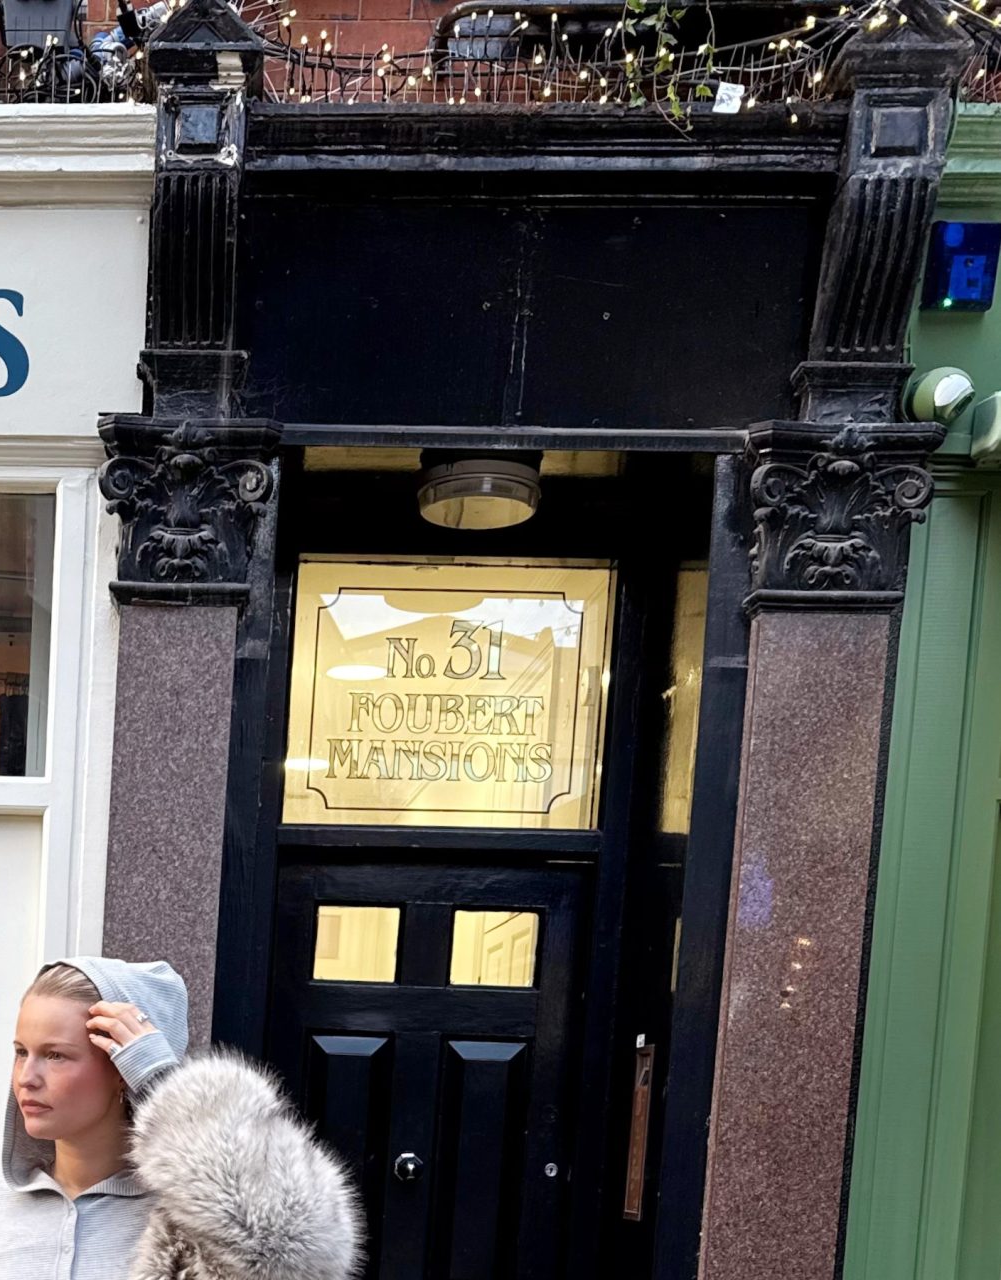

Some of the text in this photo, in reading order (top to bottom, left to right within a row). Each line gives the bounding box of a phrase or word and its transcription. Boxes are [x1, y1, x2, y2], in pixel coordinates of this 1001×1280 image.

[443, 620, 507, 681] 31
[347, 692, 545, 736] FOUBERT
[325, 738, 553, 784] MANSIONS
